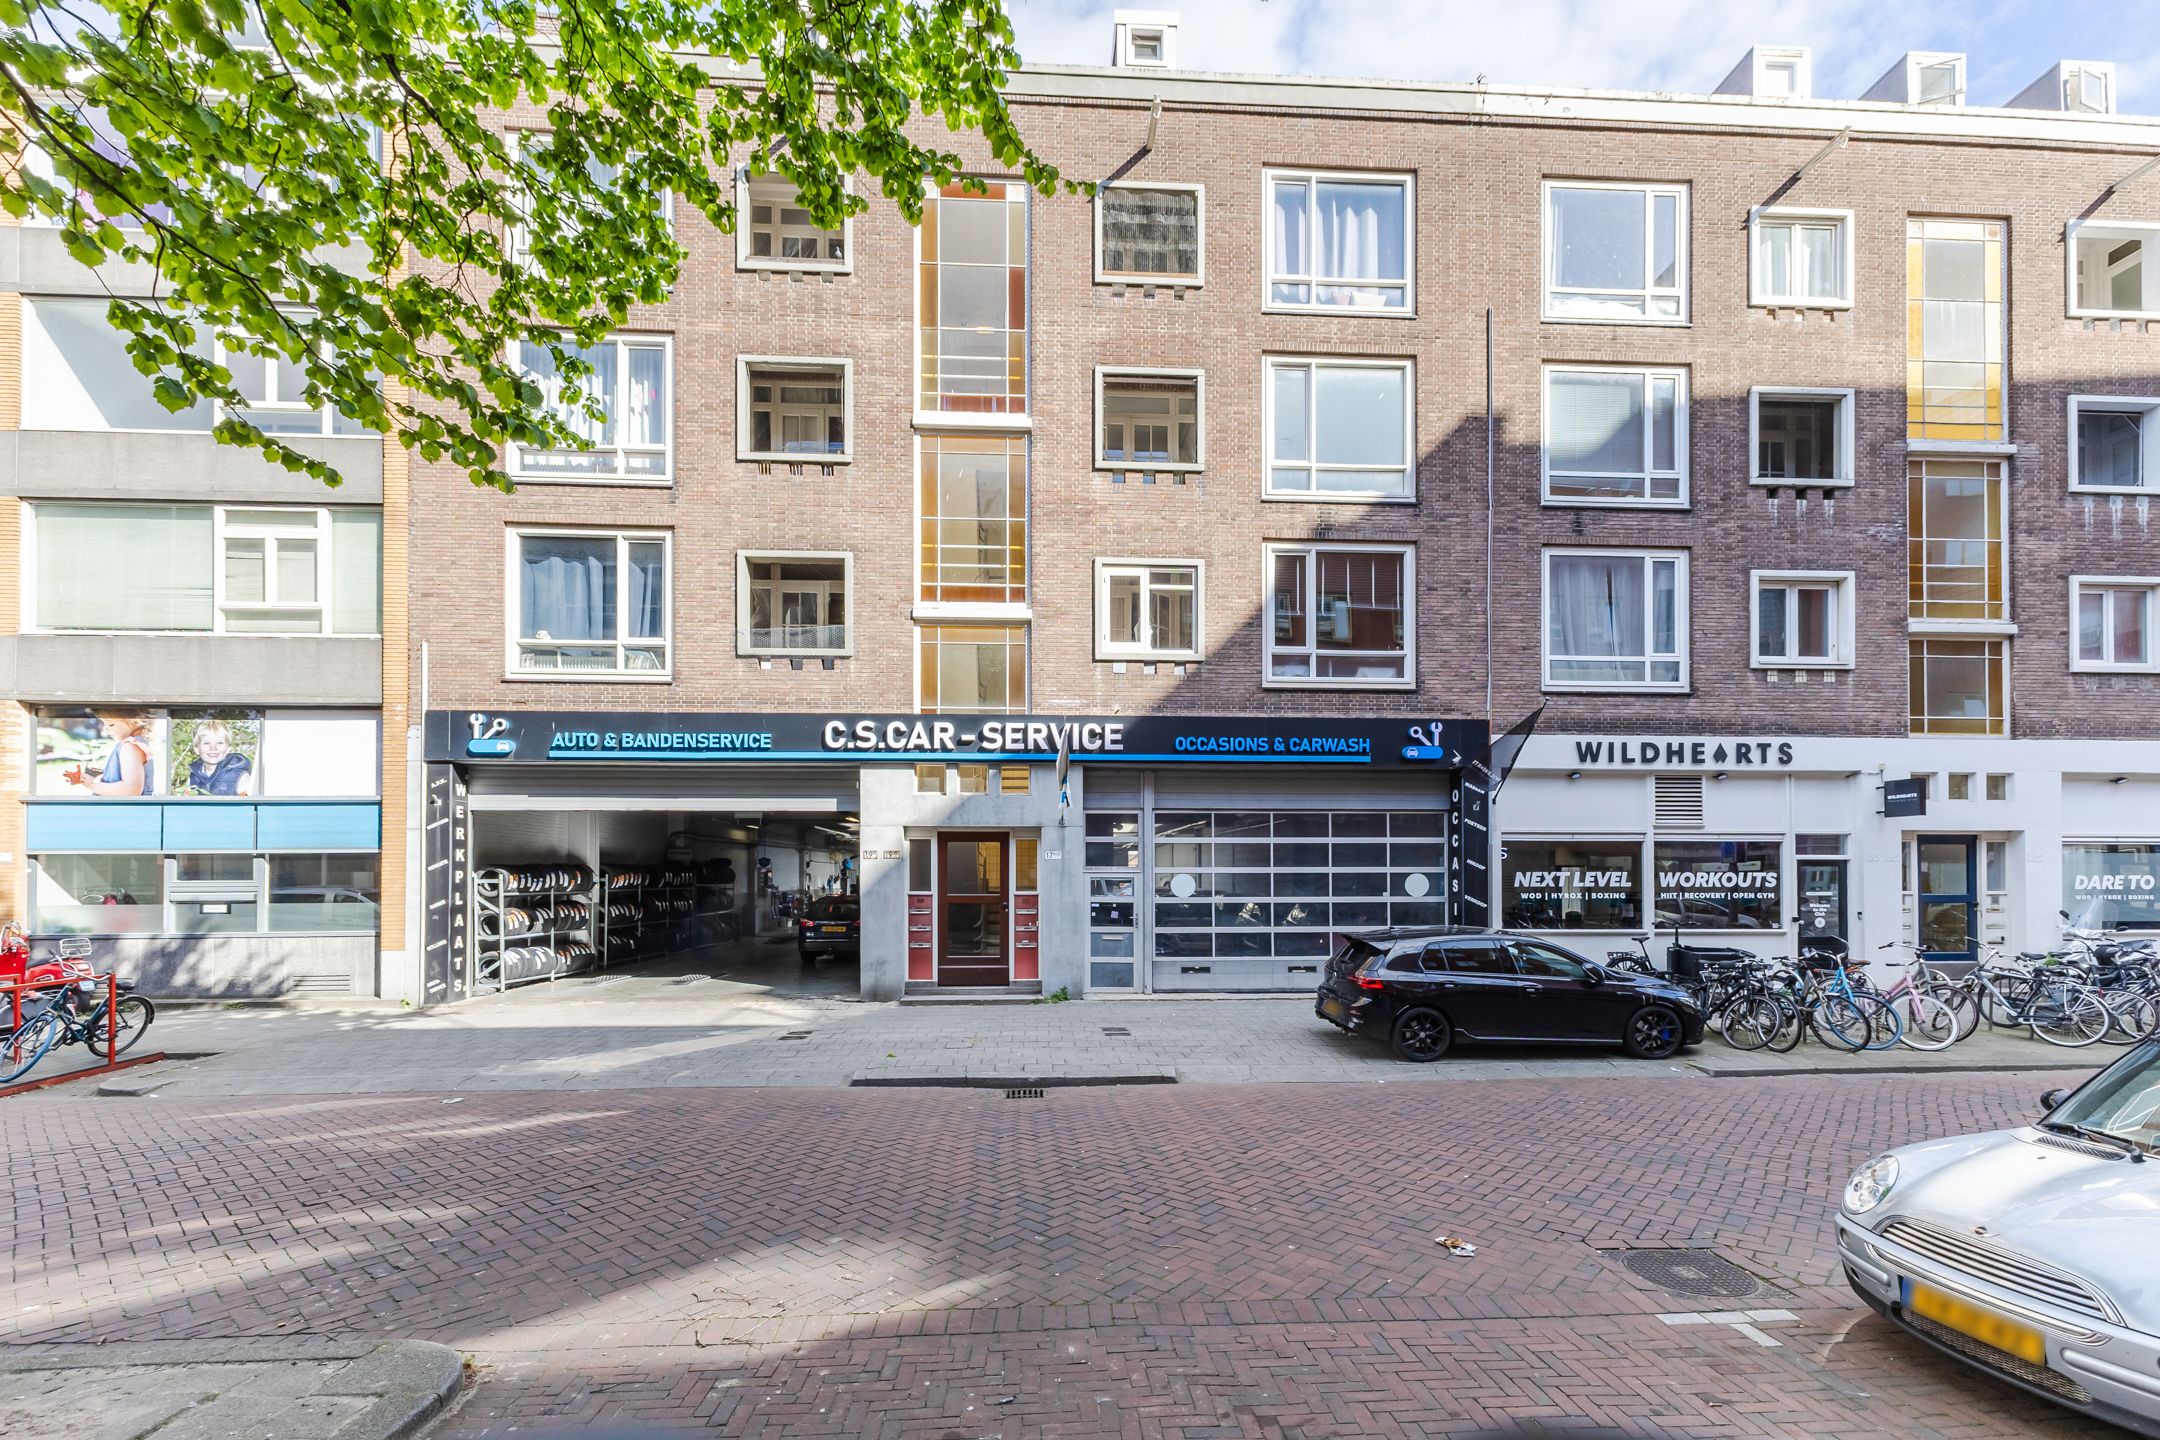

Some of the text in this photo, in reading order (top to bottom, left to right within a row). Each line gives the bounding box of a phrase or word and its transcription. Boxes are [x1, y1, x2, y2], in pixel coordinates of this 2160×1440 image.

[551, 732, 773, 749] AUTO & BANDENSERVICE
[1175, 736, 1371, 753] OCCASIONS & CARWASH
[1514, 872, 1632, 887] NEXT LEVEL
[1659, 872, 1777, 888] WORKOUTS
[2074, 875, 2155, 890] DARE TO
